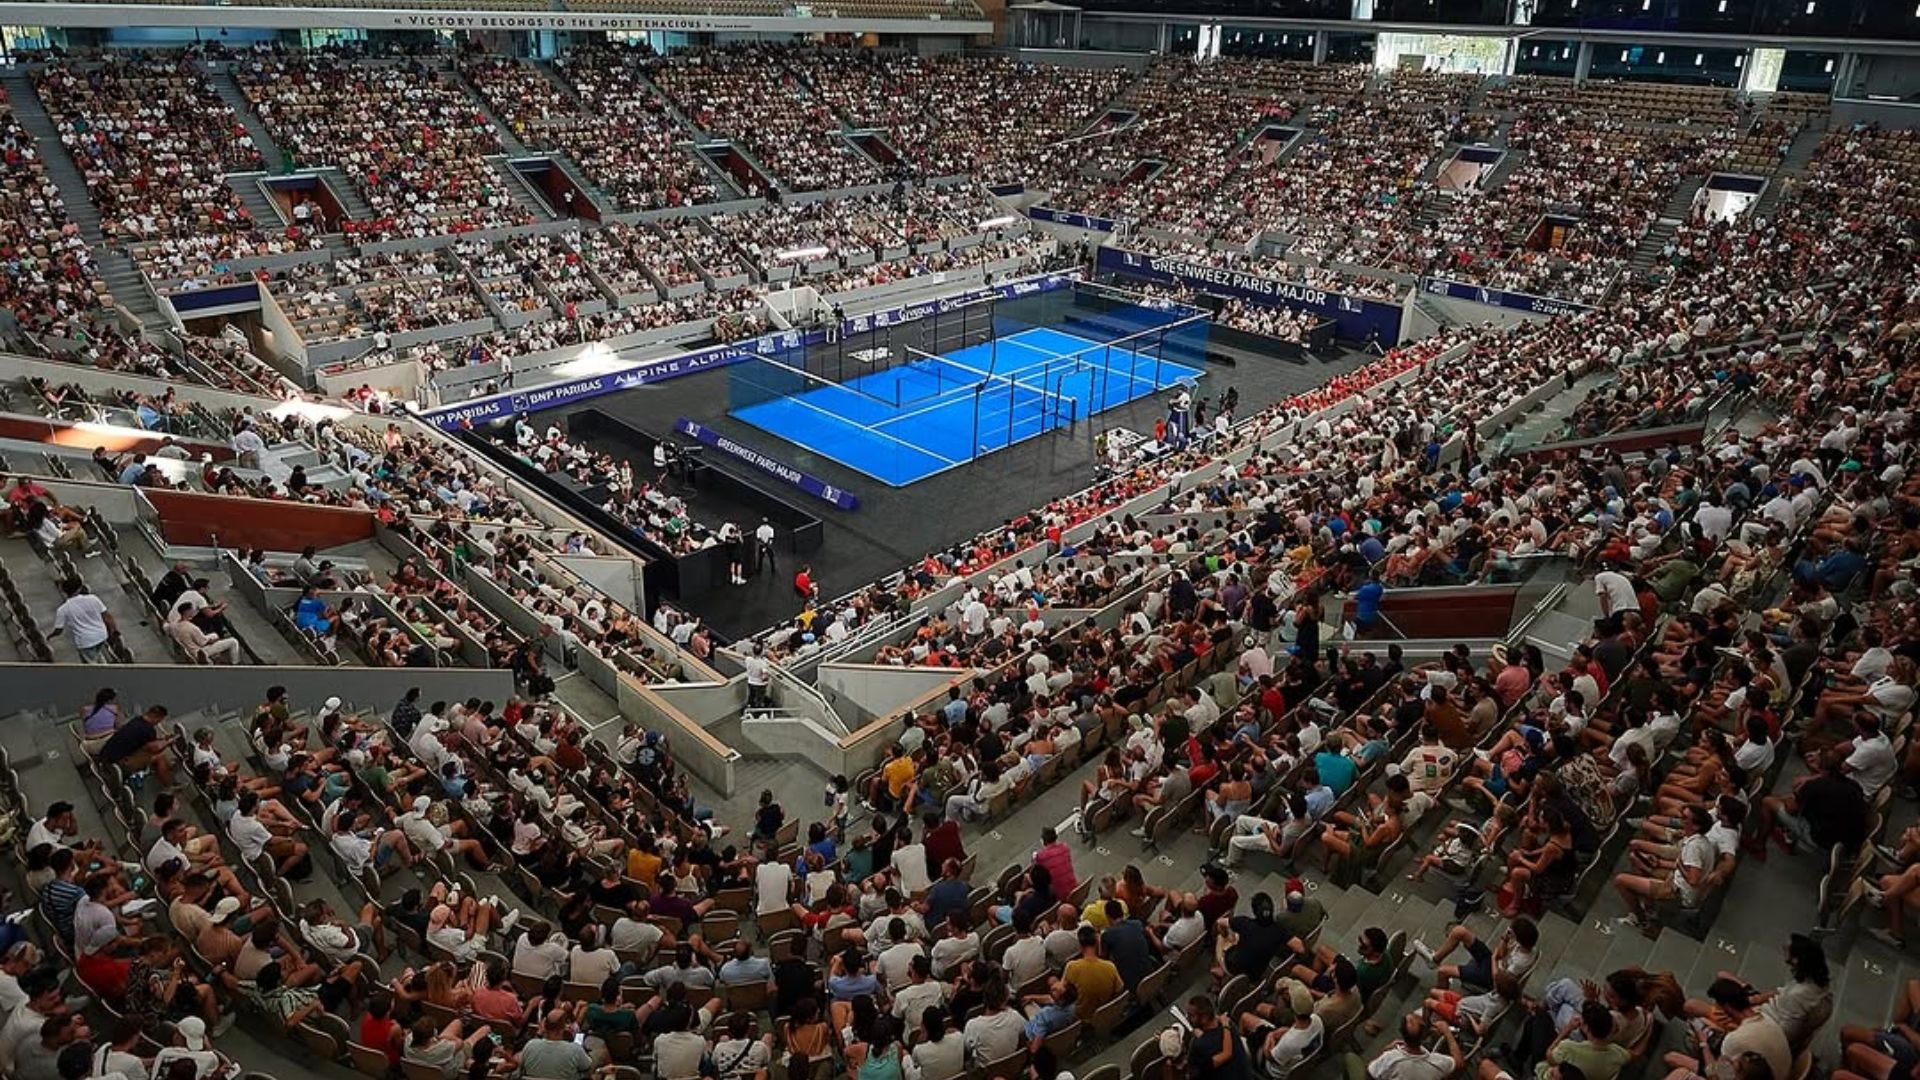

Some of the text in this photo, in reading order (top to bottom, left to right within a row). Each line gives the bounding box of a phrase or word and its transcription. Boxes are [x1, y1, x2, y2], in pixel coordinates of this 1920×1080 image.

[408, 16, 700, 28] VICTORY BELONGS TO THE MOST TENACIOUS
[1150, 260, 1326, 305] GREENWEEZ PARIS MAJOR
[614, 346, 749, 385] ALPINE ALPINE
[447, 402, 500, 424] PARIBAS
[530, 390, 555, 404] BNP
[556, 378, 602, 398] PARIBAS
[756, 455, 776, 472] PARIS
[776, 464, 802, 484] MAJOR
